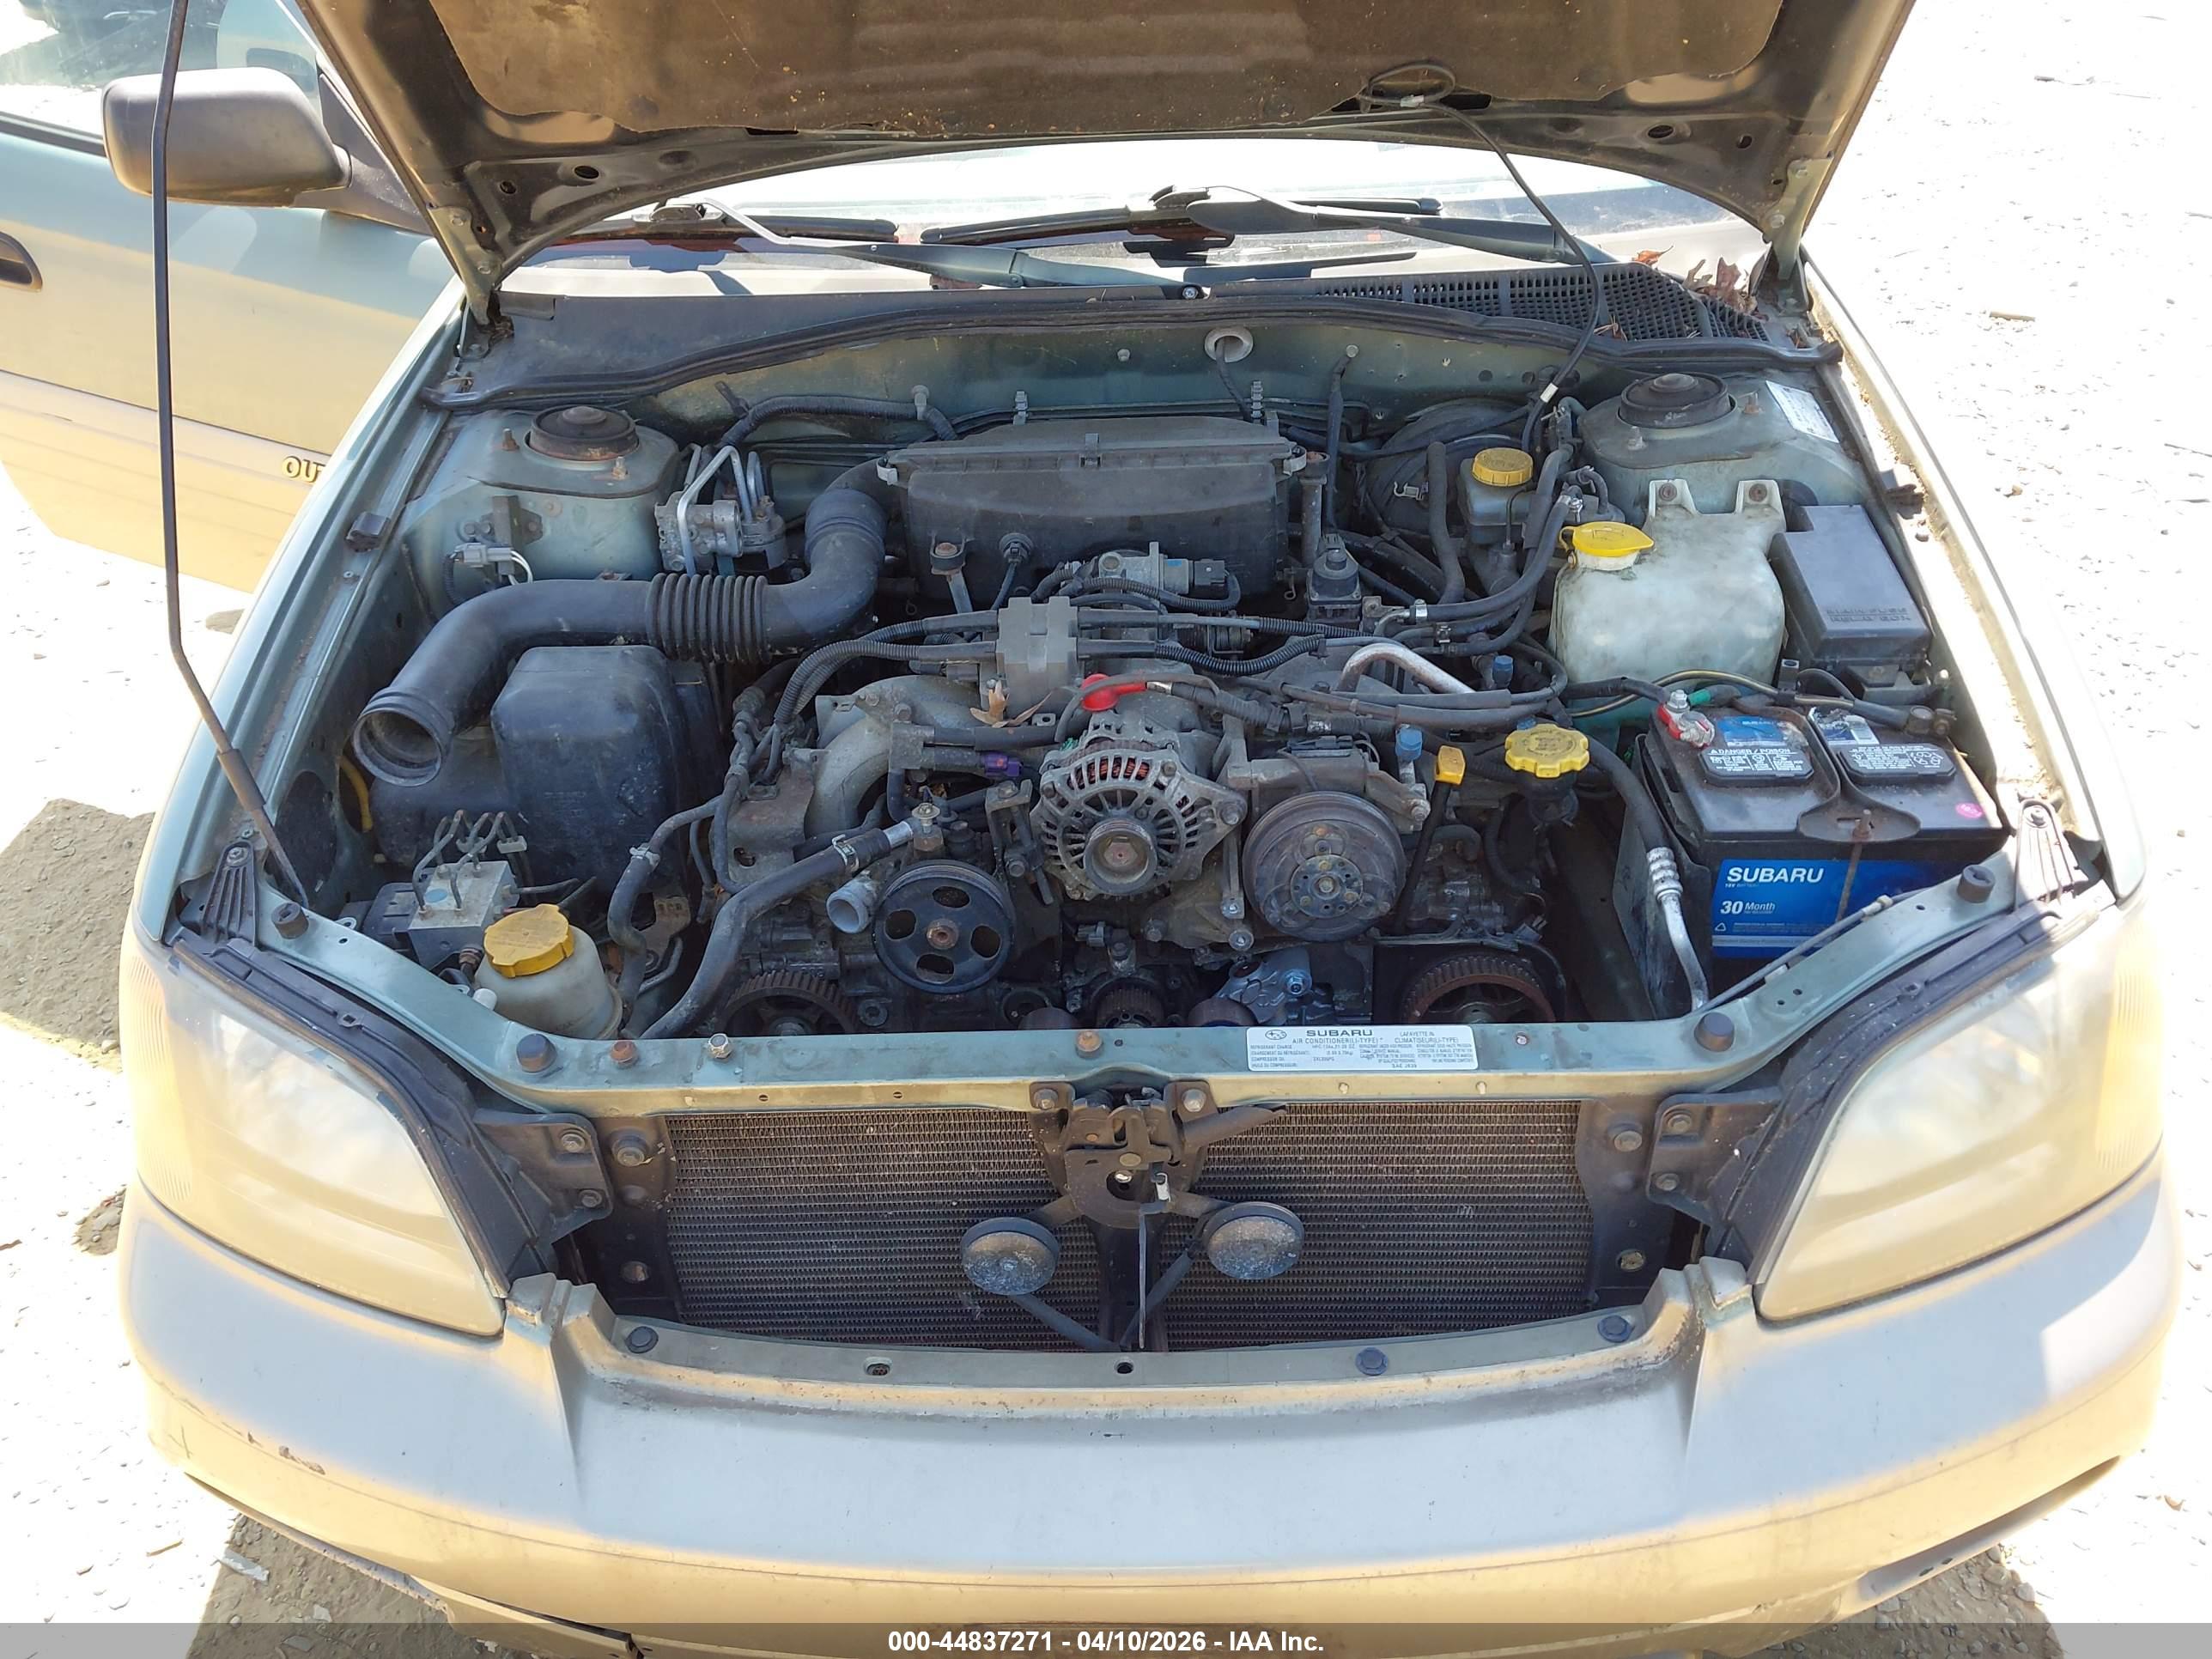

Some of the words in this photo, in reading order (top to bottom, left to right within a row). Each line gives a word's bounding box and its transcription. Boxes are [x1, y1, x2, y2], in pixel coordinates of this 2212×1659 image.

[1726, 866, 1825, 884] SUBARU
[1720, 900, 1744, 915] 30
[1744, 902, 1776, 911] Month
